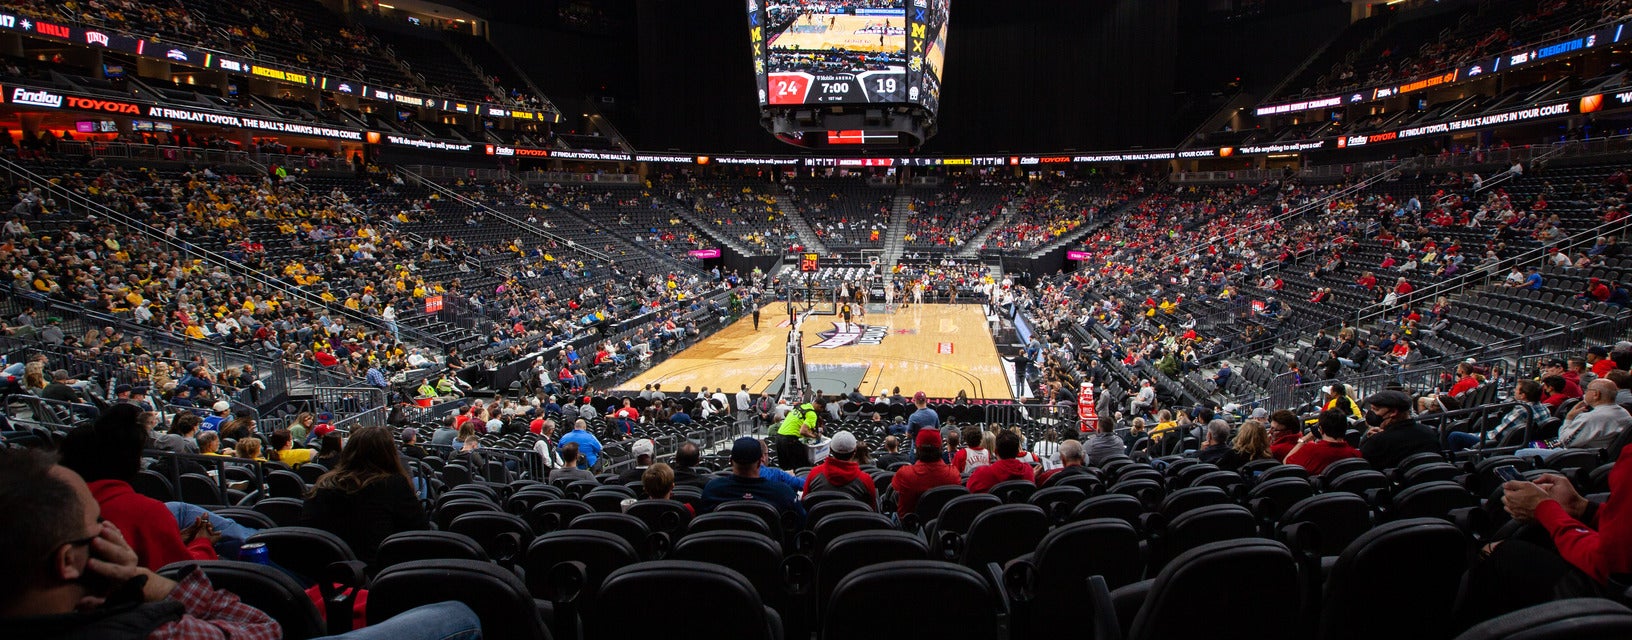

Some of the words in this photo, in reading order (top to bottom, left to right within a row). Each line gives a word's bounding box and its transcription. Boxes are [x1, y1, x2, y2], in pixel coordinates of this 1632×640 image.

[36, 22, 70, 38] UNLV
[85, 31, 108, 46] UNLV
[1538, 38, 1583, 58] CREIGHTON
[252, 66, 285, 80] ARIZONA
[286, 72, 308, 84] STATE
[1428, 76, 1444, 86] STATE
[778, 81, 798, 96] 24
[821, 83, 849, 93] 7:00
[876, 79, 896, 93] 19
[12, 88, 62, 106] Findlay
[66, 96, 140, 114] TOYOTA
[149, 107, 162, 116] AT
[164, 108, 204, 121] FINDLAY
[204, 114, 242, 127] TOYOTA,
[242, 118, 258, 128] THE
[260, 120, 284, 131] BALL'S
[284, 124, 313, 134] ALWAYS
[321, 128, 340, 138] YOUR
[1406, 127, 1426, 136] FINDLAY
[1449, 121, 1460, 130] THE
[1461, 118, 1481, 128] BALL'S
[1482, 113, 1508, 125] ALWAYS
[1509, 112, 1518, 120] IN
[1518, 107, 1539, 119] YOUR
[1540, 103, 1570, 116] COURT.
[1347, 136, 1368, 146] Findlay
[1369, 132, 1397, 142] TOYOTA
[802, 260, 816, 270] 24
